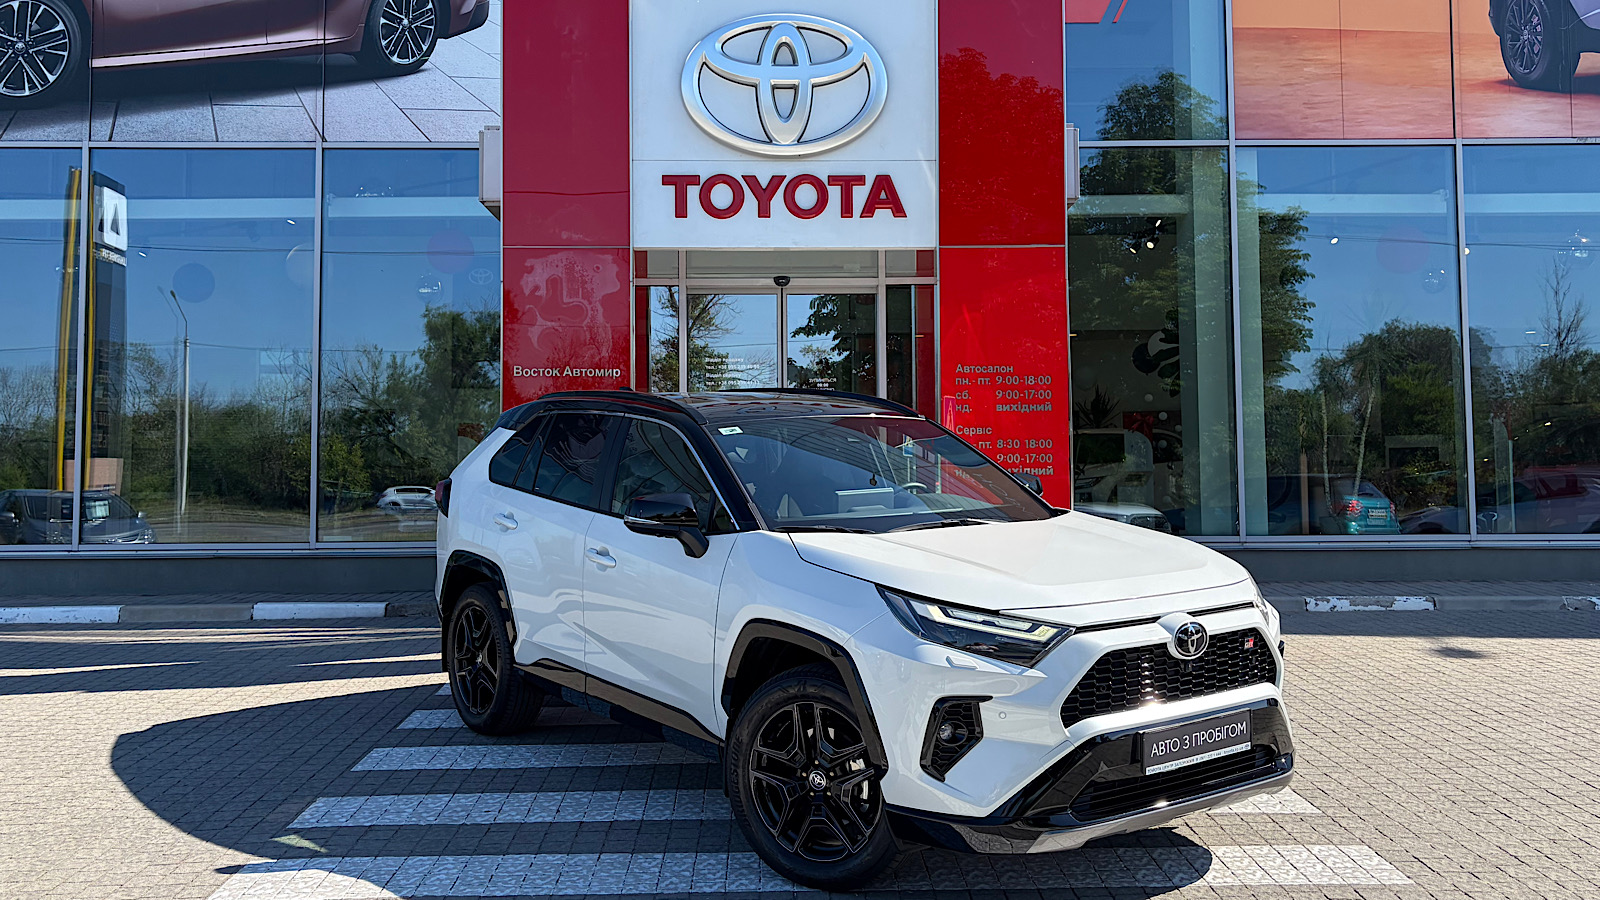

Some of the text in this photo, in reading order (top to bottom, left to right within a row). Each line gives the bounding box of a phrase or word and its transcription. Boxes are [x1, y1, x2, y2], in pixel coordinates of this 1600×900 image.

[662, 174, 907, 219] TOYOTA
[513, 366, 621, 379] Восток Автомир
[955, 364, 1014, 374] Автосалон
[995, 376, 1052, 385] 9:00-18:00
[955, 390, 1052, 399] сб. 9:00-17:00
[955, 402, 1052, 413] нд. вихідний
[955, 425, 993, 436] Сервіс
[996, 439, 1020, 449] 8:30
[1025, 439, 1053, 449] 18:00
[996, 454, 1053, 463] 9:00-17:00
[1150, 738, 1180, 757] АВТО
[1182, 735, 1190, 749] З
[1192, 720, 1247, 747] ПРОБІГОМ
